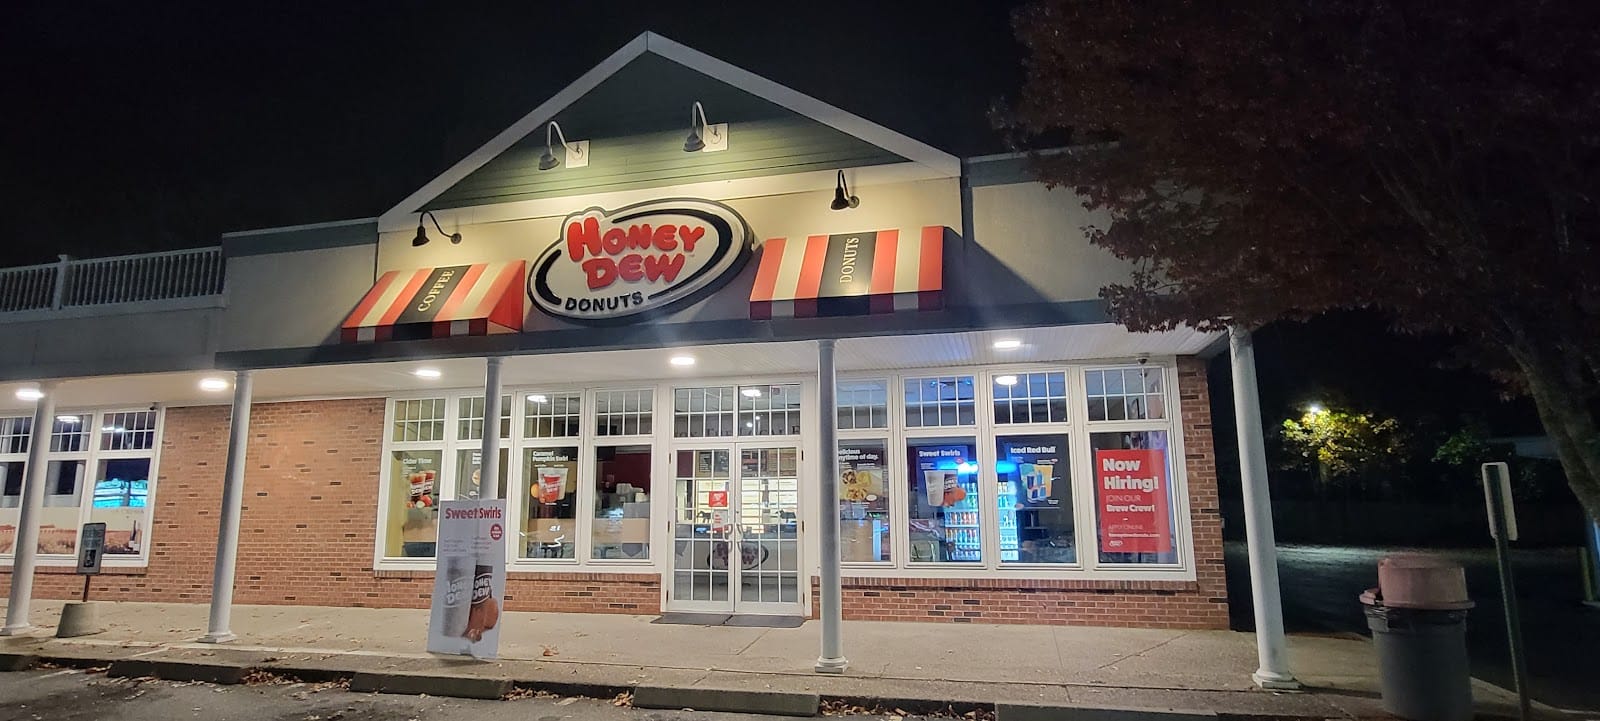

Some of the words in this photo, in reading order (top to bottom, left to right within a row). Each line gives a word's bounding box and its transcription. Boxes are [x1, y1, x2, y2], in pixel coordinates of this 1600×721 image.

[567, 216, 705, 262] HONEY
[839, 237, 860, 283] DONUTS
[581, 253, 686, 290] DEW
[417, 270, 455, 312] COFFEE
[564, 291, 644, 312] DONUTS
[940, 449, 961, 457] Swirls
[1026, 446, 1041, 454] Red
[838, 454, 859, 462] nytime
[1102, 458, 1141, 472] Now
[1103, 475, 1159, 492] Hiring!
[1105, 494, 1123, 502] JOIN
[1123, 494, 1142, 502] OUR
[445, 507, 479, 520] Sweet
[479, 505, 502, 520] Swirls
[1106, 504, 1129, 512] Brew
[1129, 504, 1155, 512] Crew!
